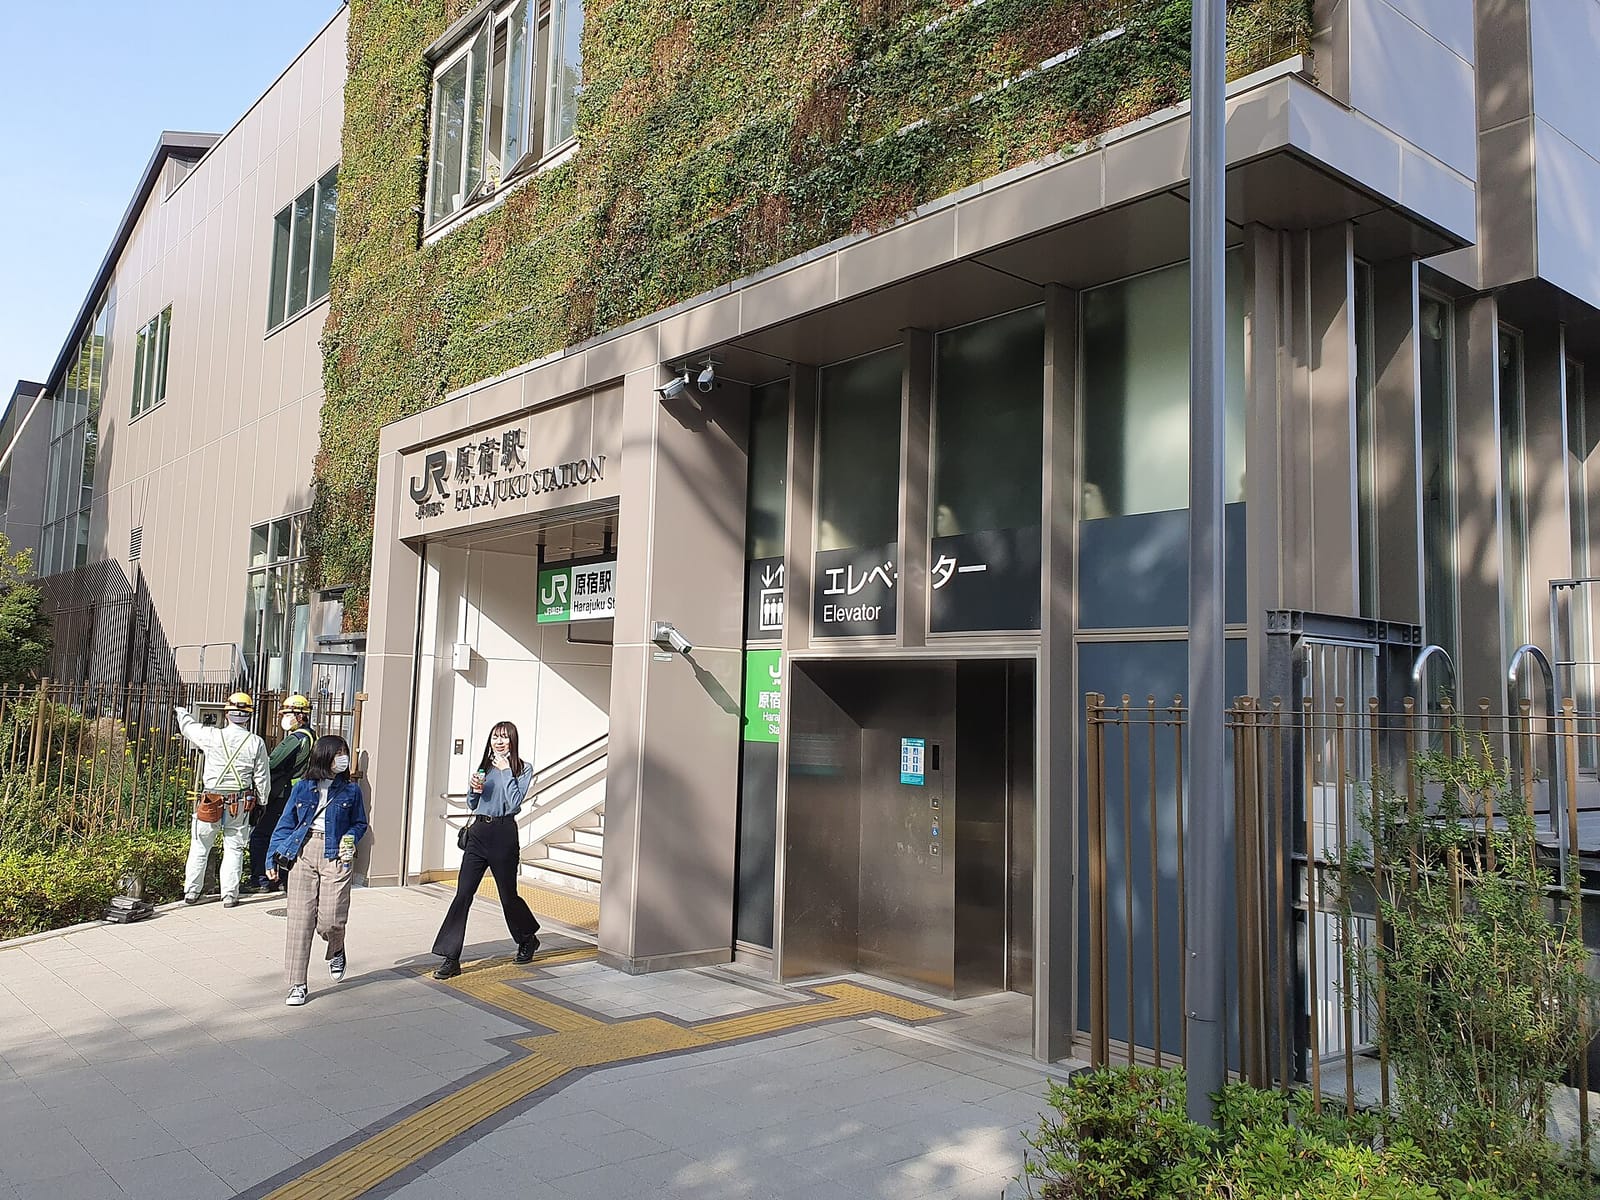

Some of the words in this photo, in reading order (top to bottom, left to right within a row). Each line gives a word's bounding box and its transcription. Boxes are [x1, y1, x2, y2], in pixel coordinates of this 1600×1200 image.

[454, 429, 527, 484] 原宿駅
[410, 451, 450, 505] JR
[455, 474, 531, 510] HARAJUKU
[532, 455, 606, 495] STATION
[541, 574, 568, 605] JR
[574, 570, 612, 596] 原宿駅
[573, 599, 606, 614] Harajuku
[823, 604, 882, 623] Elevator
